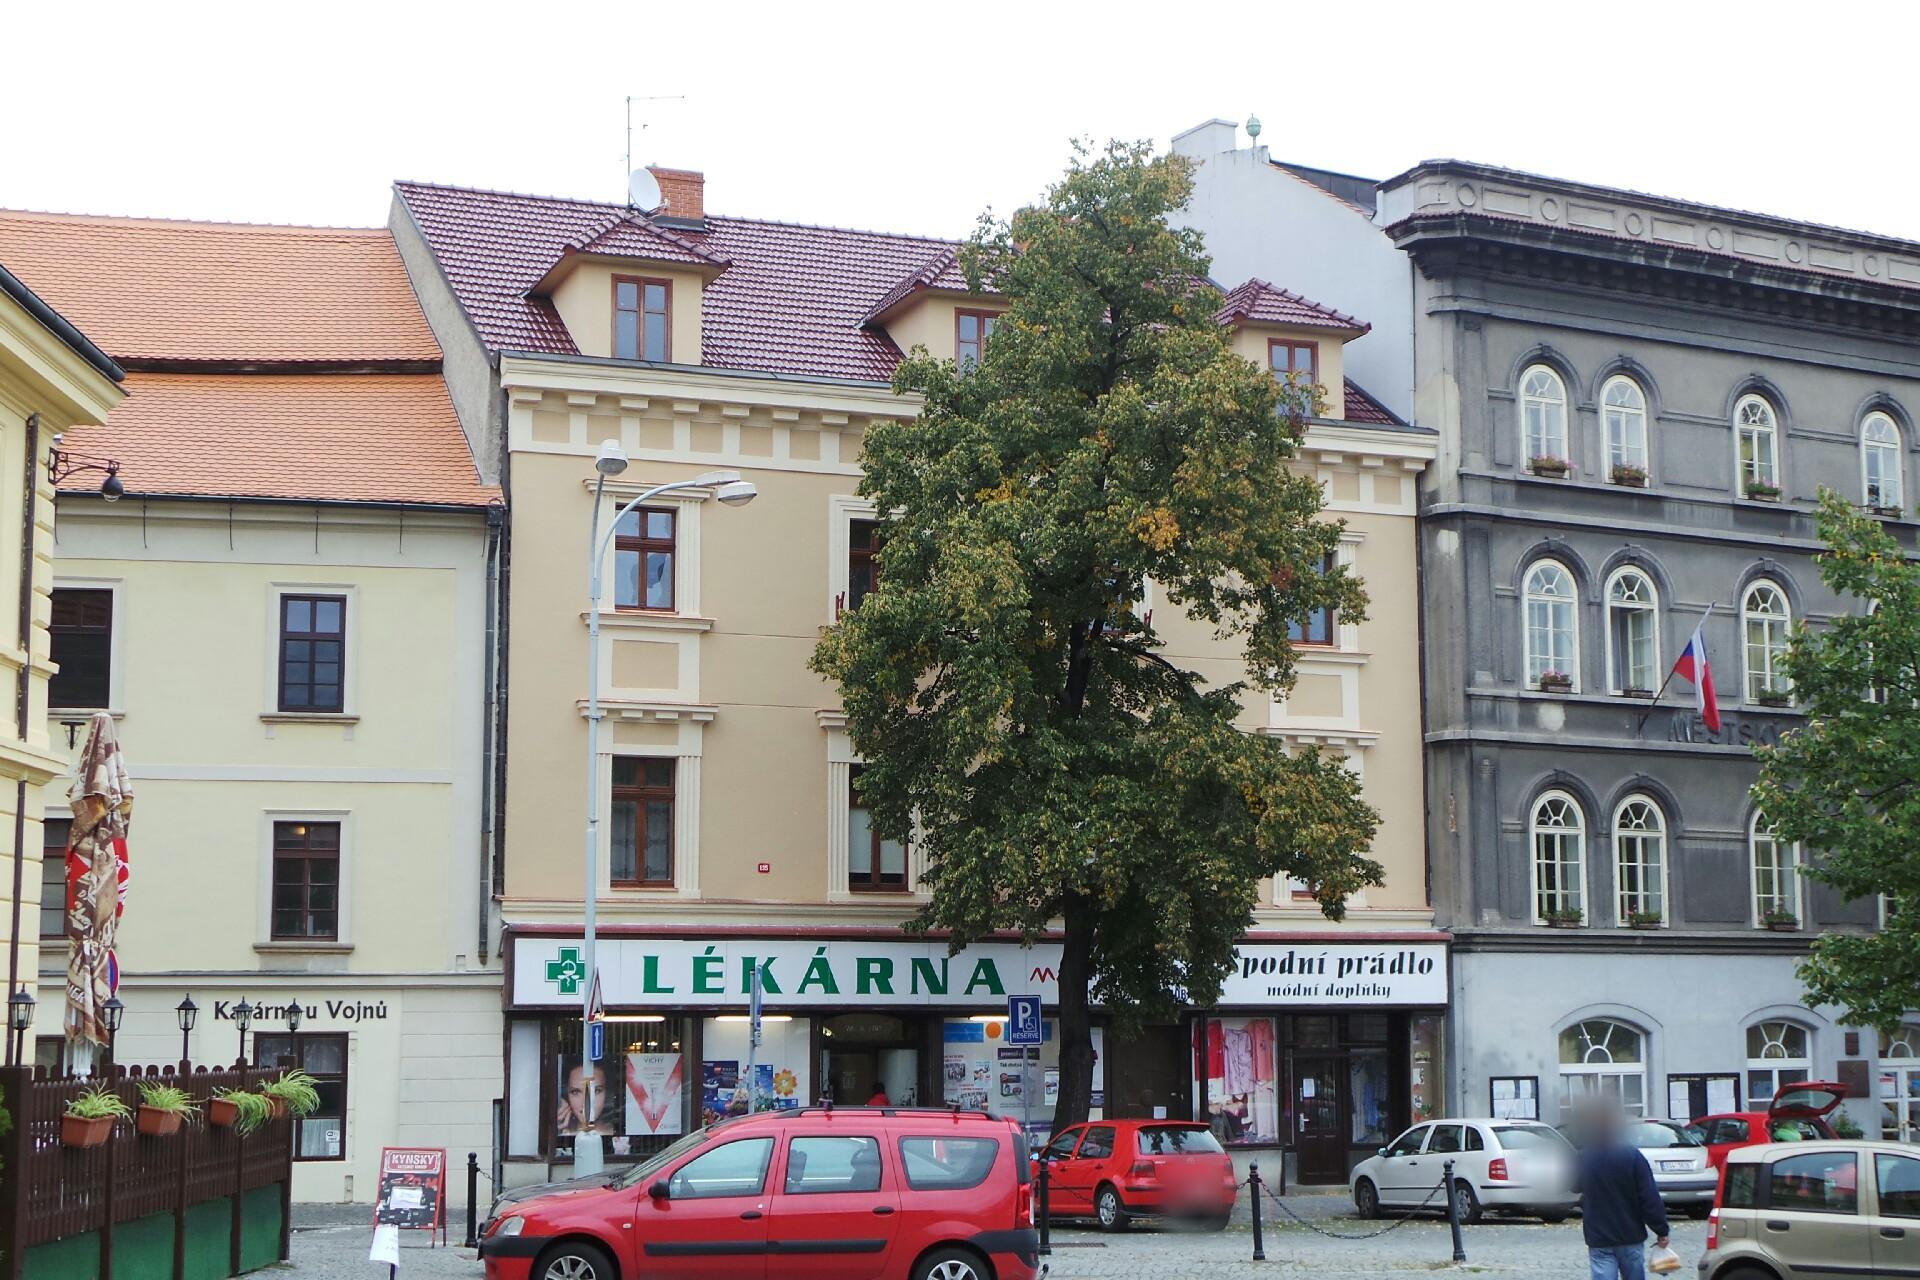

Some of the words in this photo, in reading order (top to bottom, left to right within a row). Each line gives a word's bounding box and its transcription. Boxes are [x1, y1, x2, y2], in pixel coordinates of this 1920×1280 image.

[642, 946, 1007, 995] LÉKÁRNA
[1337, 951, 1434, 979] prádlo
[1267, 983, 1319, 997] módní
[1325, 983, 1391, 998] doplňky
[214, 1001, 297, 1020] Kaárn
[306, 1005, 317, 1019] u
[326, 1000, 388, 1023] Vojnů
[1018, 1002, 1032, 1029] P
